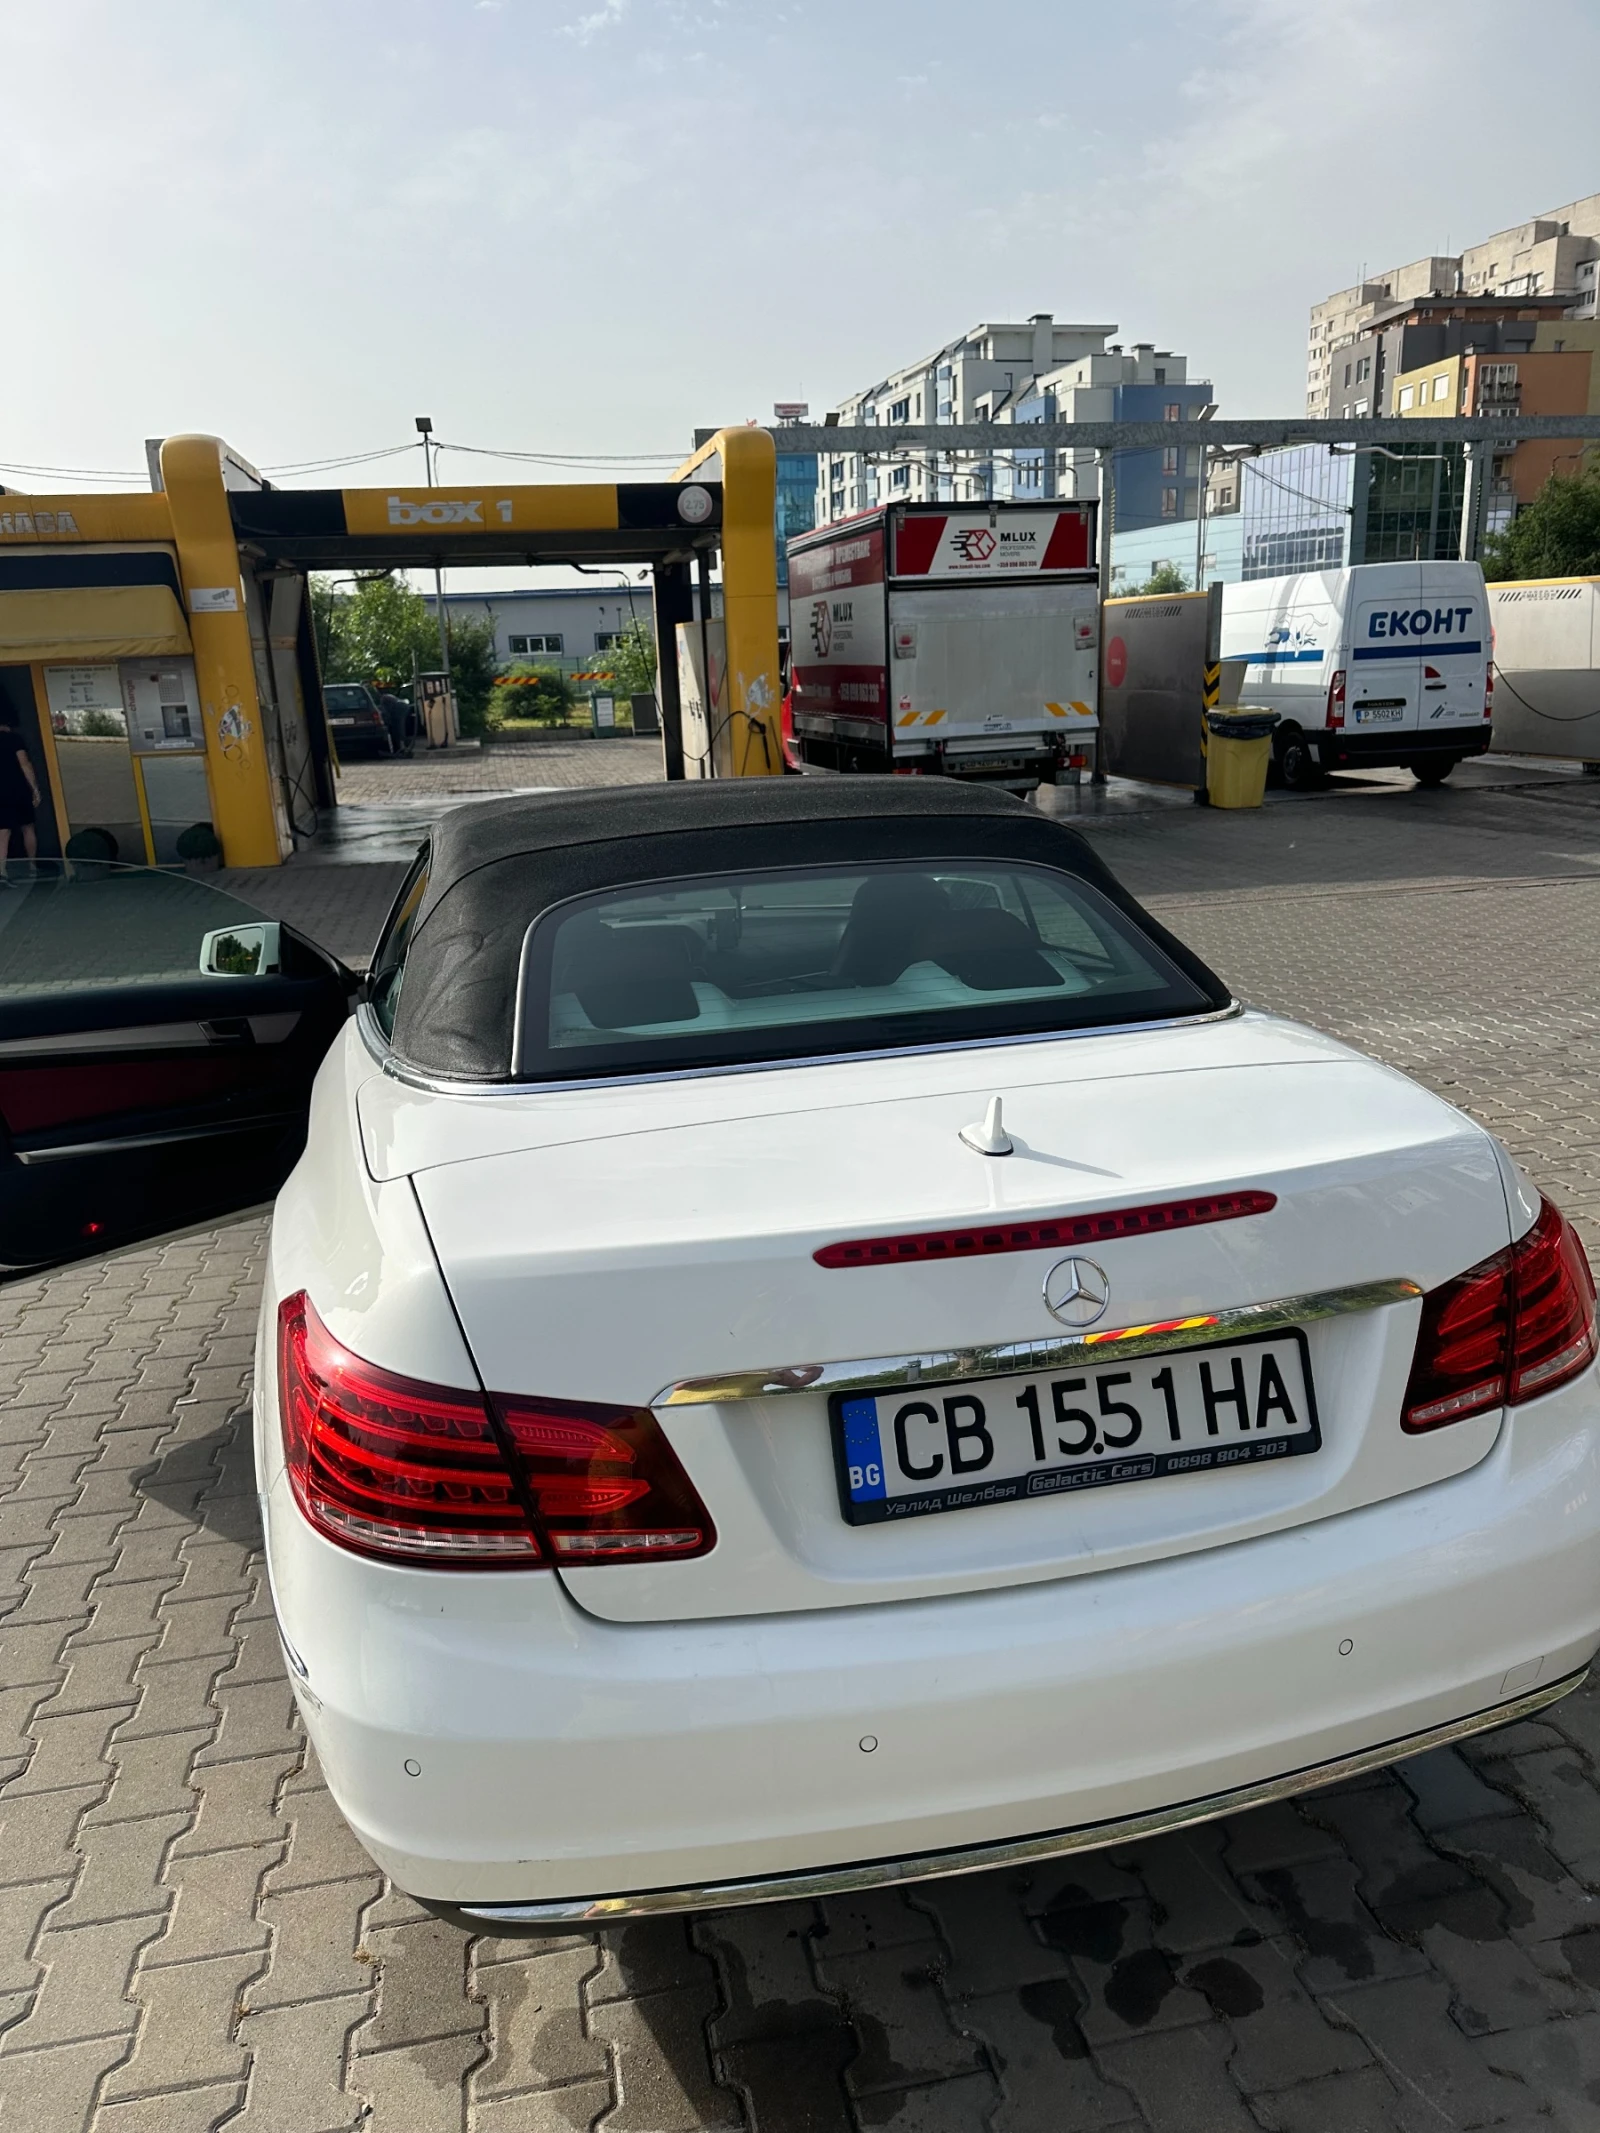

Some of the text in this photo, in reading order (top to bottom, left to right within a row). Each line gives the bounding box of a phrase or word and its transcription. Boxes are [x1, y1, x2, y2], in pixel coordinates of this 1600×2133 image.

[387, 496, 513, 525] box 1
[685, 499, 705, 510] 2.75
[1000, 531, 1037, 542] MLUX
[832, 601, 853, 622] MLUX
[1368, 607, 1473, 638] ЕКОНТ
[1364, 711, 1370, 719] P
[893, 1353, 1298, 1481] CB 1551 HA
[1167, 1441, 1288, 1471] 0898 804 303
[848, 1463, 881, 1490] BG
[1031, 1461, 1152, 1491] Galactic Cars
[885, 1484, 1017, 1516] Уалид Шелбая
